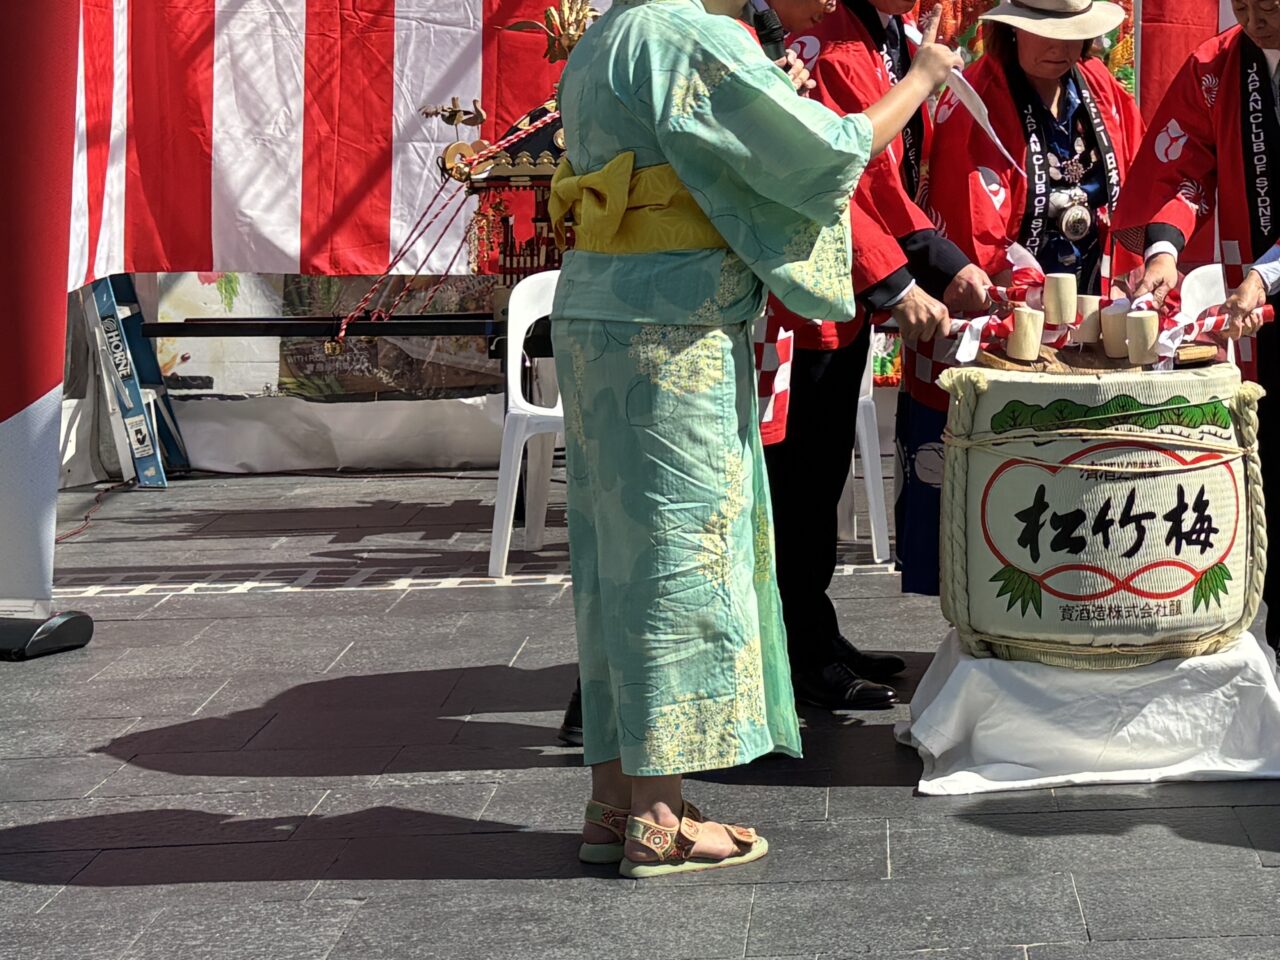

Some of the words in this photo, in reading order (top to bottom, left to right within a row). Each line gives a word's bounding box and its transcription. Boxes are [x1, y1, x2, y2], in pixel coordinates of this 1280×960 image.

[1247, 62, 1262, 112] JAPAN
[1024, 104, 1041, 152] JAPAN
[1250, 113, 1265, 152] CLUB
[1032, 154, 1046, 194] CLUB
[1254, 154, 1266, 175] OF
[1034, 196, 1046, 217] OF
[1256, 177, 1272, 236] SYDNEY
[1025, 218, 1043, 256] SYDN
[108, 329, 131, 378] HORNE
[1014, 483, 1219, 564] 松竹梅
